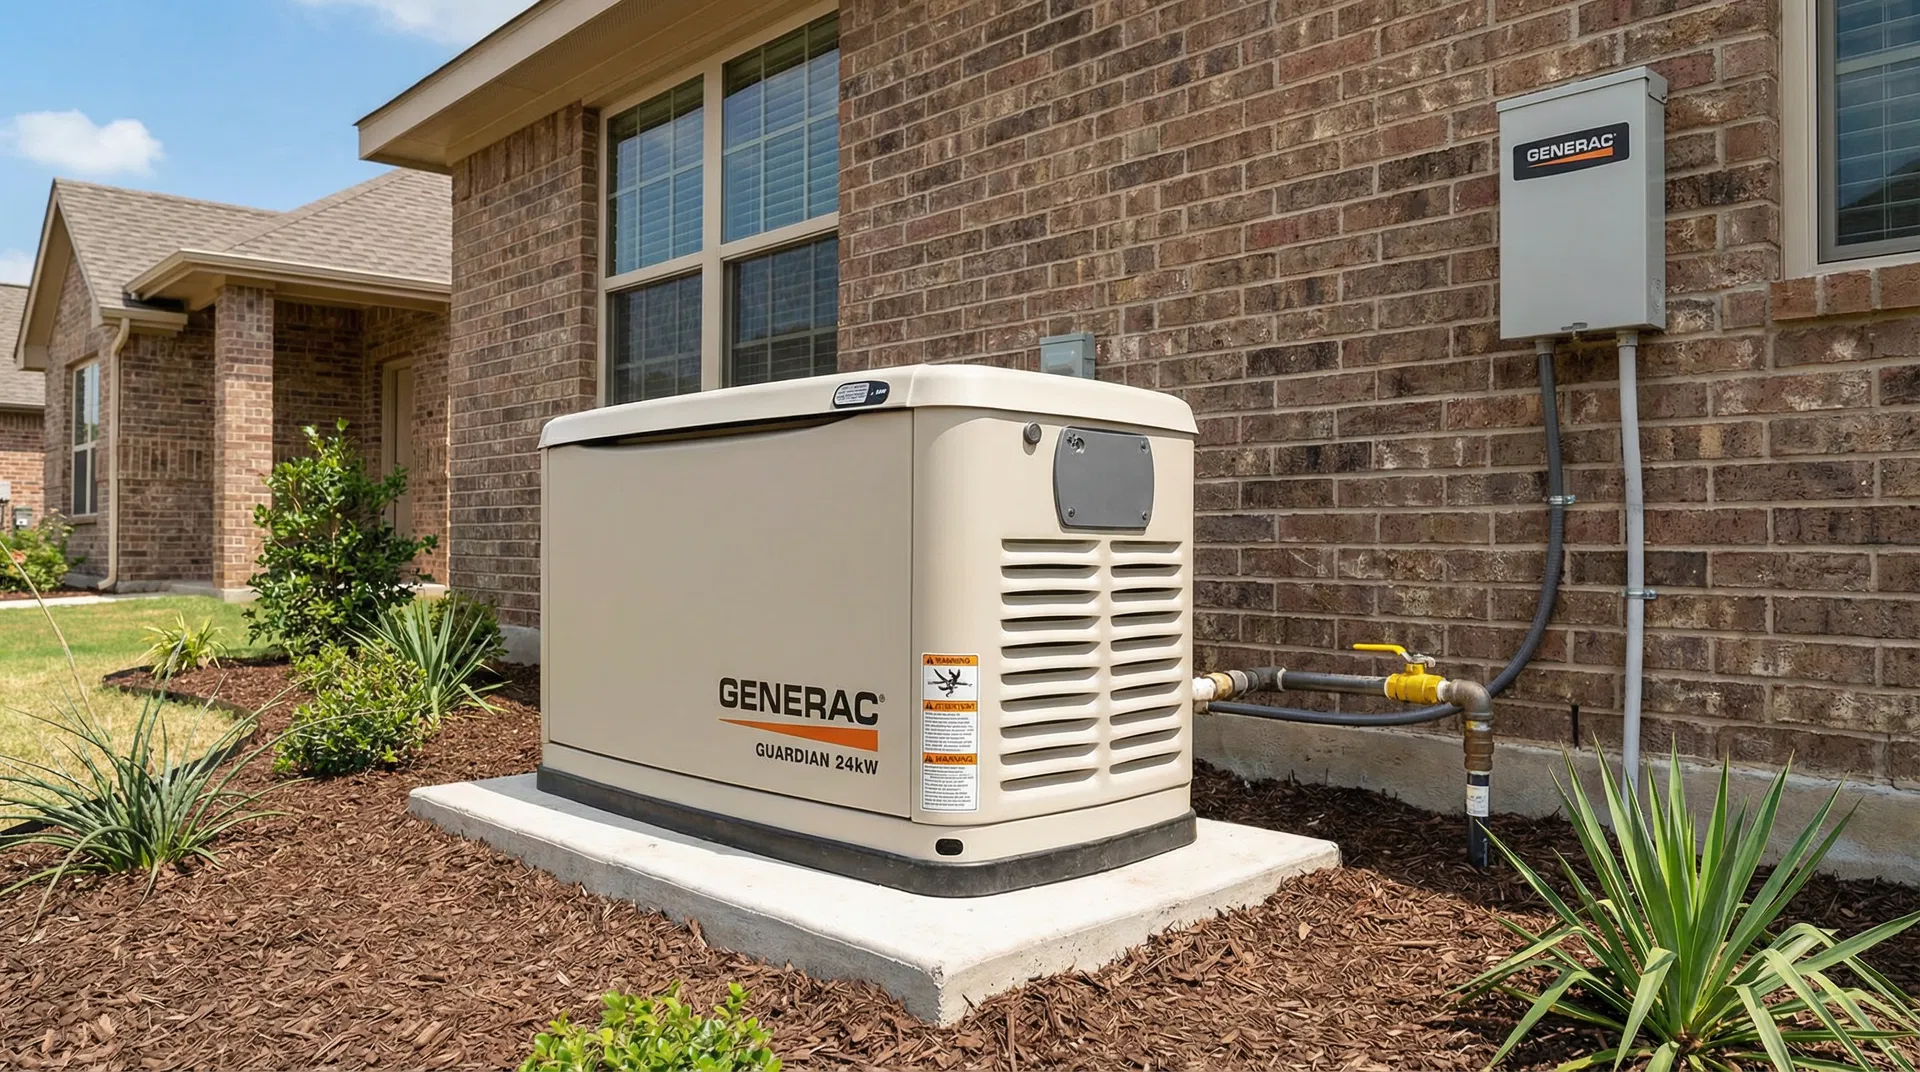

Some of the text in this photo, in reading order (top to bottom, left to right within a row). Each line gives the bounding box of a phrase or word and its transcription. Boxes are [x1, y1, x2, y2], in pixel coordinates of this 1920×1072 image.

[1526, 133, 1615, 162] GENERAC
[719, 677, 879, 726] GENERAC
[755, 742, 879, 775] GUARDIAN 24kW
